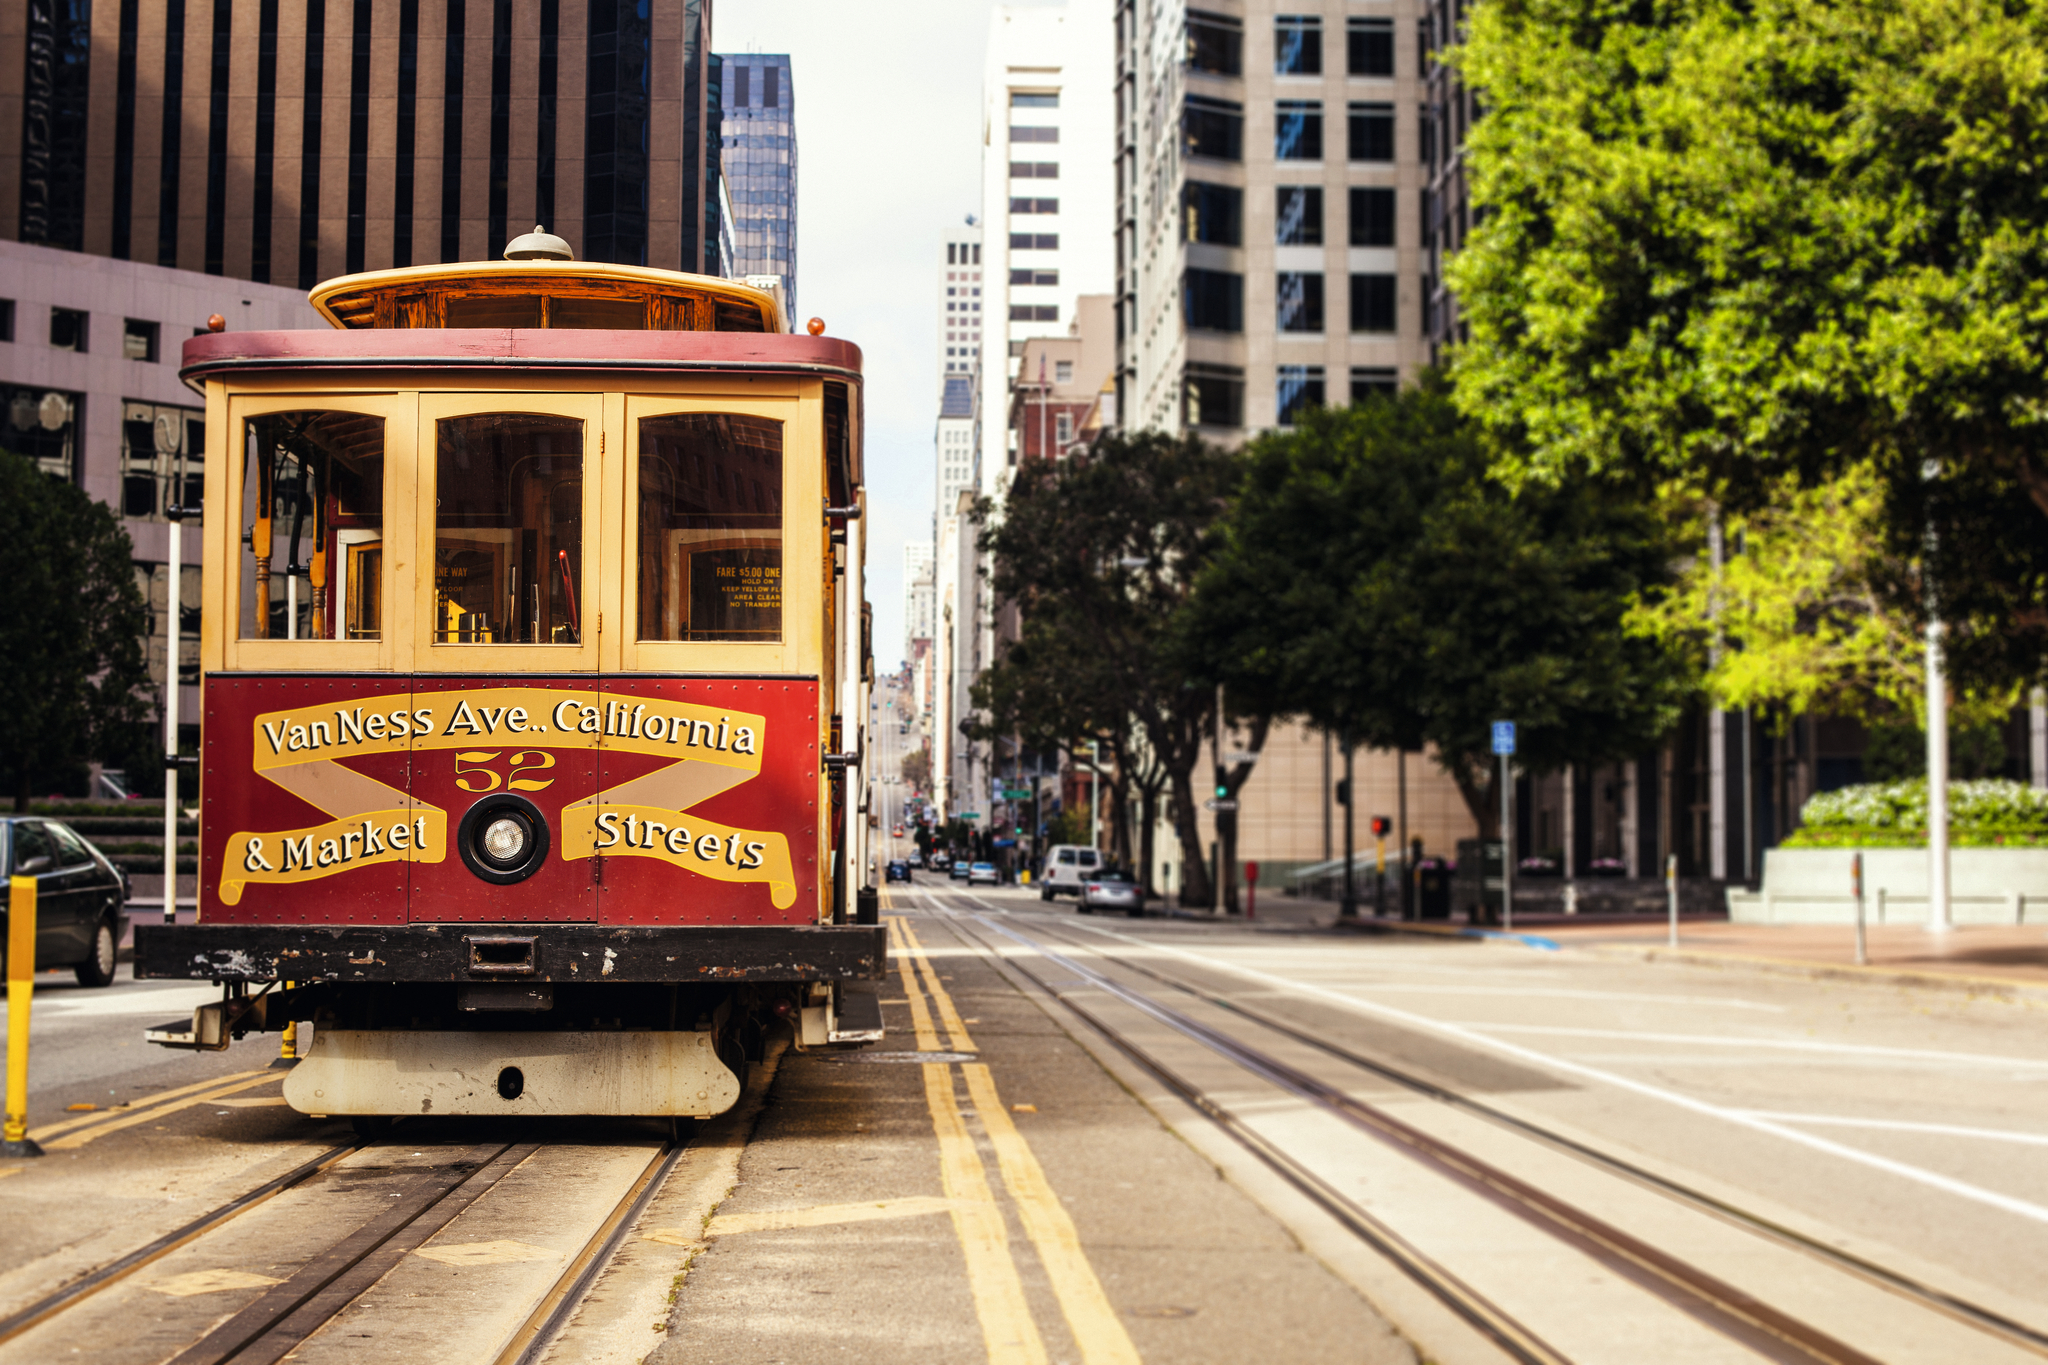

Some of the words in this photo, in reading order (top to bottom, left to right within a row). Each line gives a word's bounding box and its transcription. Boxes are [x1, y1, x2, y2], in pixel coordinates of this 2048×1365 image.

[451, 567, 468, 577] WAY
[716, 567, 736, 577] FARE
[739, 567, 762, 577] $5.00
[764, 567, 781, 577] ONE
[262, 718, 332, 755] Van
[334, 707, 435, 745] Ness
[552, 700, 756, 755] California
[455, 750, 556, 792] 52
[244, 837, 274, 872] &
[278, 816, 427, 873] Market
[594, 812, 767, 871] Streets
